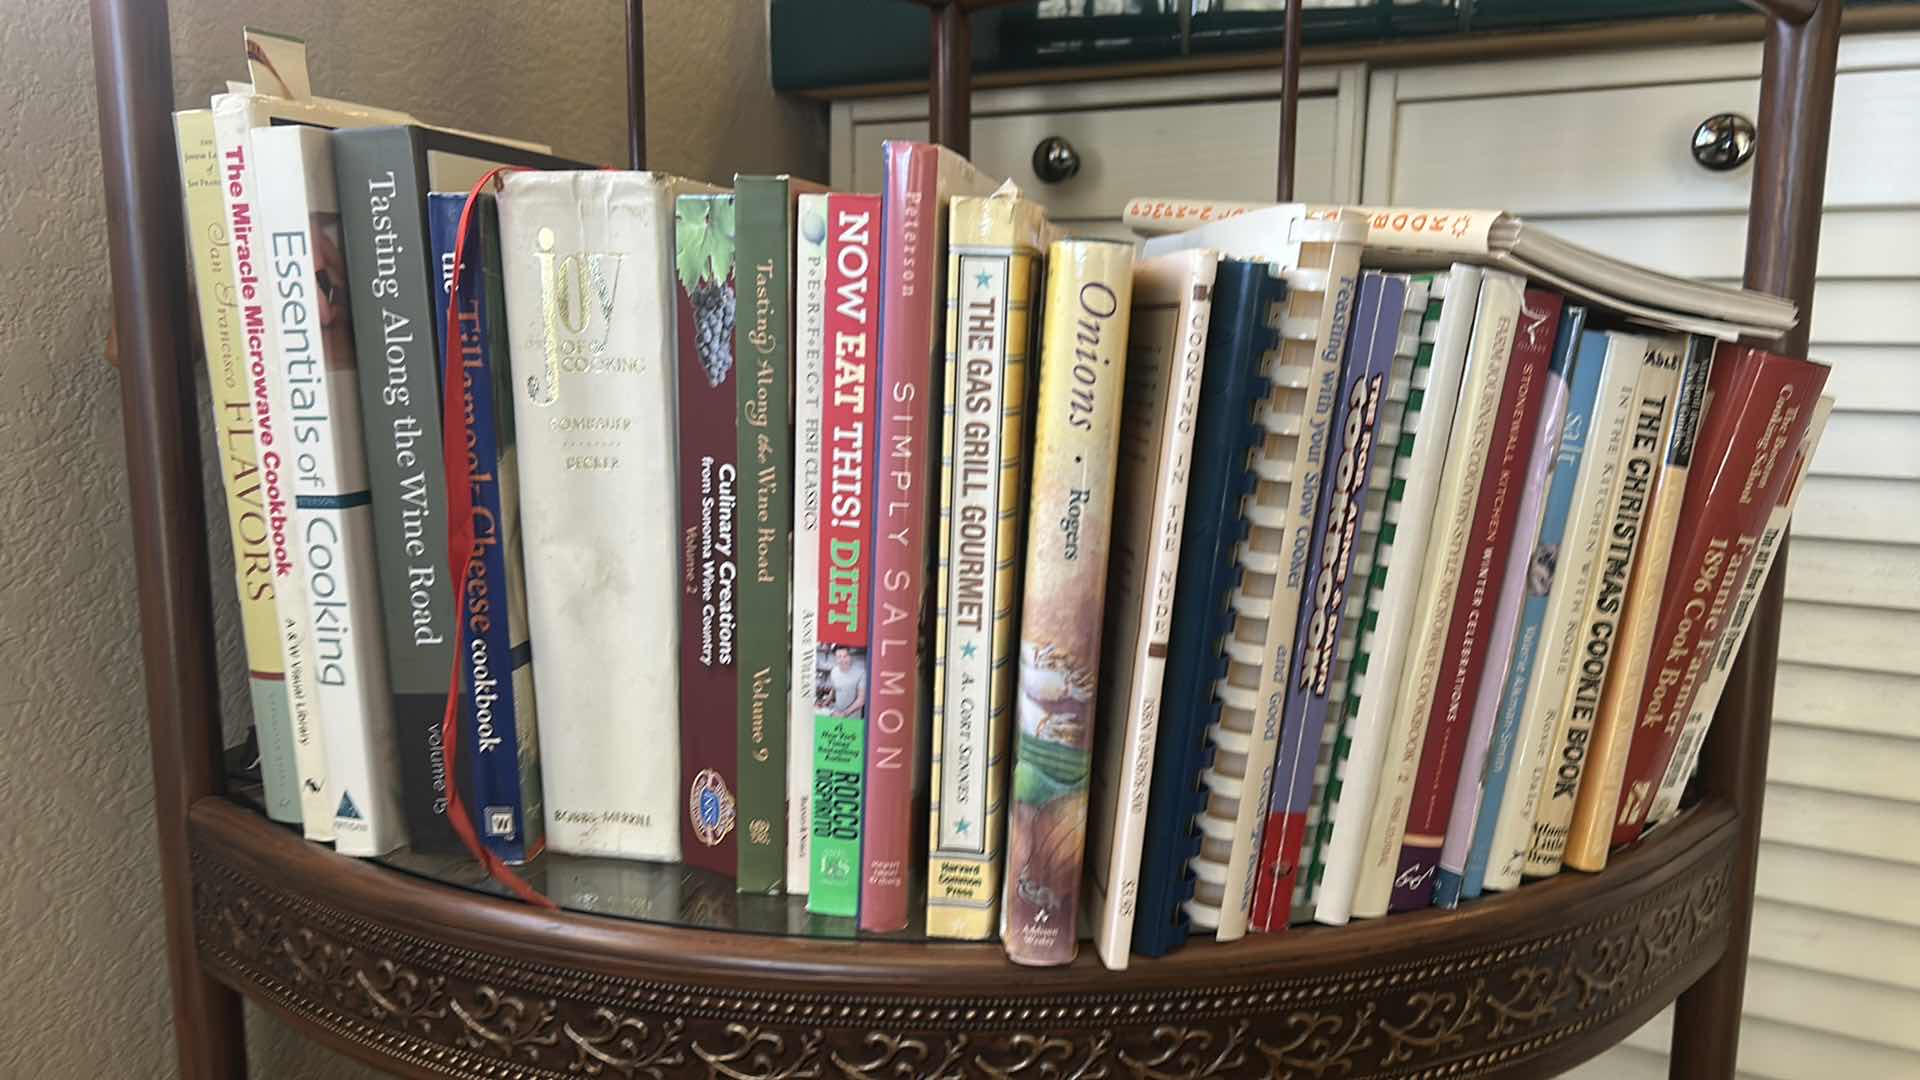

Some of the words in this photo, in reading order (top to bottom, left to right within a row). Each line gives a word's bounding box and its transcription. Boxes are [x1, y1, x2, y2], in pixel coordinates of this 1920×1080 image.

[225, 145, 246, 198] The
[207, 222, 230, 273] San
[231, 203, 259, 300] Miracle
[367, 171, 404, 298] Tasting
[836, 210, 871, 324] NOW
[901, 191, 922, 297] Peterson
[214, 281, 238, 389] Francisco
[272, 231, 328, 443] Essentials
[527, 226, 624, 407] joy
[749, 258, 776, 354] Tasting
[967, 296, 996, 351] THE
[1321, 275, 1354, 362] Feasting
[243, 305, 273, 446] Microwave
[382, 307, 413, 407] Along
[744, 359, 775, 428] Along
[834, 331, 867, 414] EAT
[964, 358, 993, 415] GAS
[1068, 281, 1117, 431] Onions
[1178, 313, 1205, 435] COOKING
[1316, 369, 1337, 414] with
[393, 415, 422, 467] the
[961, 421, 991, 497] GRILL
[1307, 417, 1329, 464] your
[1631, 394, 1667, 454] THE
[1756, 383, 1795, 450] Cooking
[225, 402, 275, 601] FLAVORS
[297, 453, 325, 488] of
[701, 455, 714, 494] from
[757, 465, 776, 523] Wine
[831, 421, 863, 529] THIS!
[887, 381, 916, 547] SIMPLY
[1300, 471, 1320, 519] Slow
[1738, 449, 1770, 505] School
[263, 450, 293, 577] Cookbook
[400, 471, 430, 557] Wine
[701, 496, 715, 559] Sonoma
[715, 462, 737, 557] Culinary
[1059, 488, 1091, 561] Rogers
[1299, 374, 1369, 690] COOKBOOK
[1596, 456, 1651, 617] CHRISTMAS
[467, 506, 497, 634] Cheese
[701, 559, 715, 602] Wine
[757, 527, 776, 583] Road
[828, 537, 861, 633] DIET
[956, 504, 987, 633] GOURMET
[1287, 527, 1310, 590] Cooker
[1471, 545, 1495, 608] WINTER
[1692, 534, 1729, 594] 1896
[1703, 533, 1758, 632] Fannie
[306, 517, 348, 686] Cooking
[407, 564, 444, 646] Road
[699, 603, 716, 667] Country
[717, 560, 737, 666] Creations
[1665, 599, 1706, 662] Cook
[471, 638, 503, 753] cookbook
[752, 666, 772, 744] Volume
[875, 568, 911, 769] SALMON
[1446, 608, 1480, 723] CELEBRATIONS
[1571, 621, 1614, 723] COOKIE
[1639, 667, 1683, 730] Book
[1662, 637, 1717, 738] Farmer
[832, 770, 861, 841] ROCCO
[1551, 726, 1588, 801] BOOK
